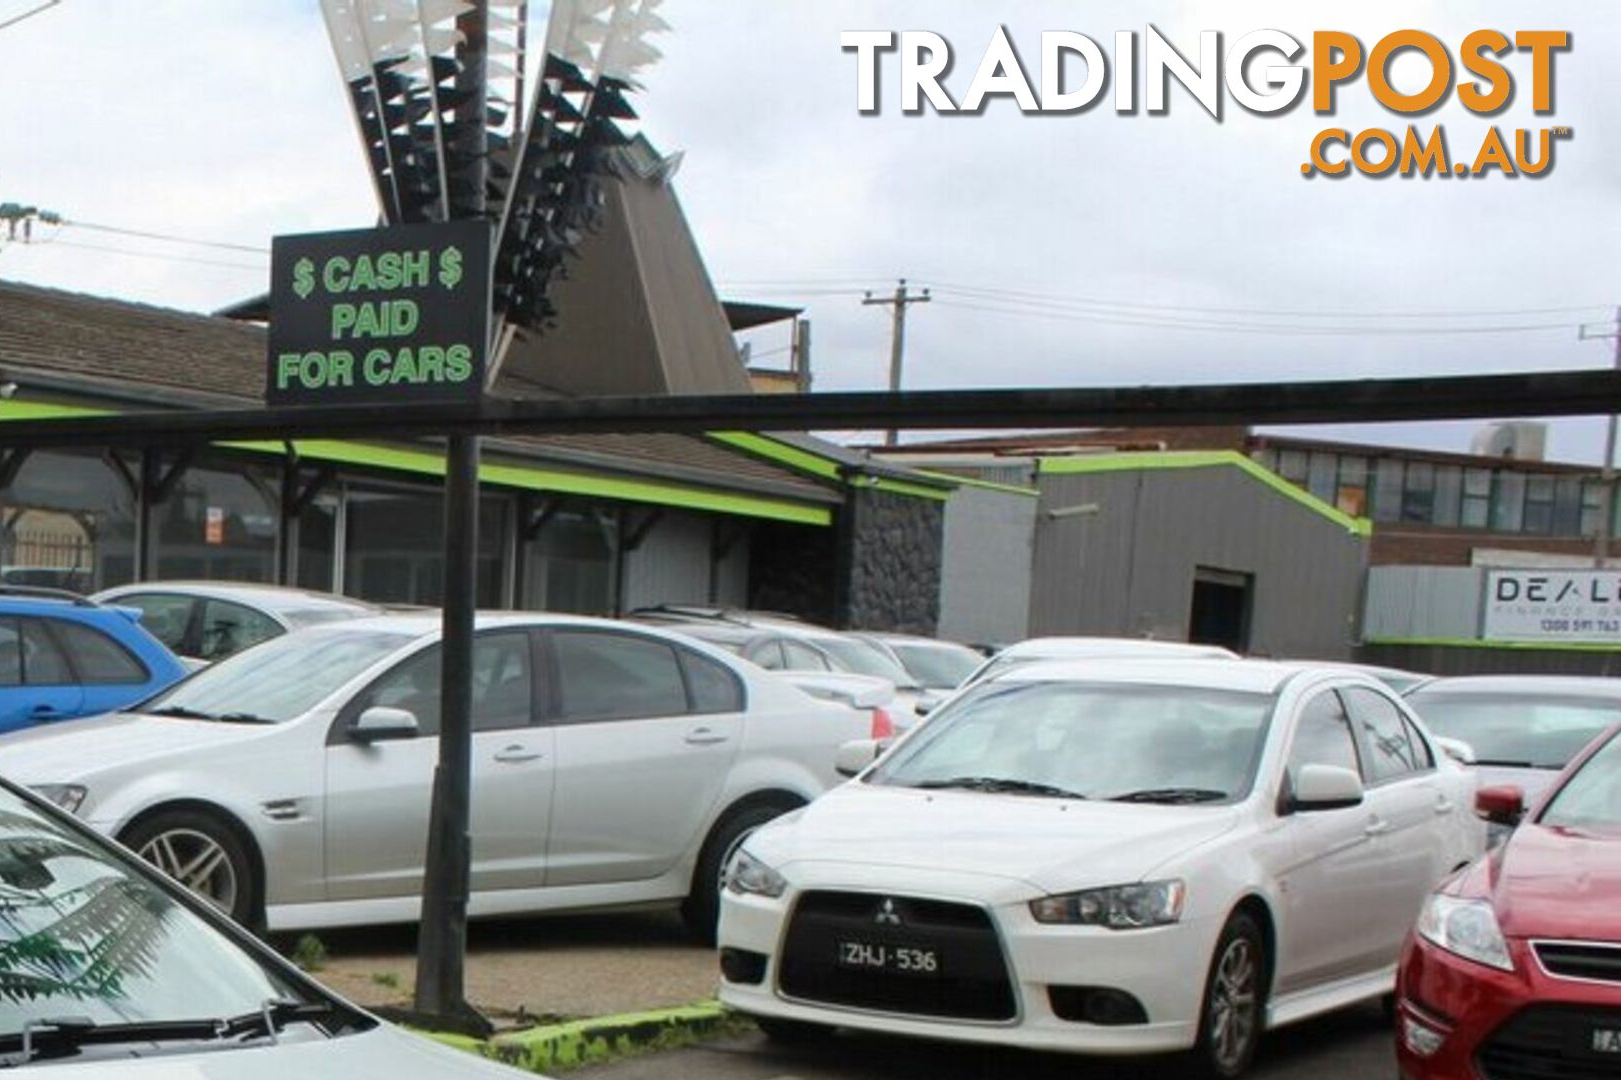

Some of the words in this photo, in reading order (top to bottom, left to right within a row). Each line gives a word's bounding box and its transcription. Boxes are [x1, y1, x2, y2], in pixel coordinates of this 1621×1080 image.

[292, 257, 315, 299] $
[323, 251, 429, 293] CASH
[438, 245, 463, 289] $
[332, 299, 419, 340] PAID
[276, 351, 354, 389] FOR
[363, 344, 473, 386] CARS
